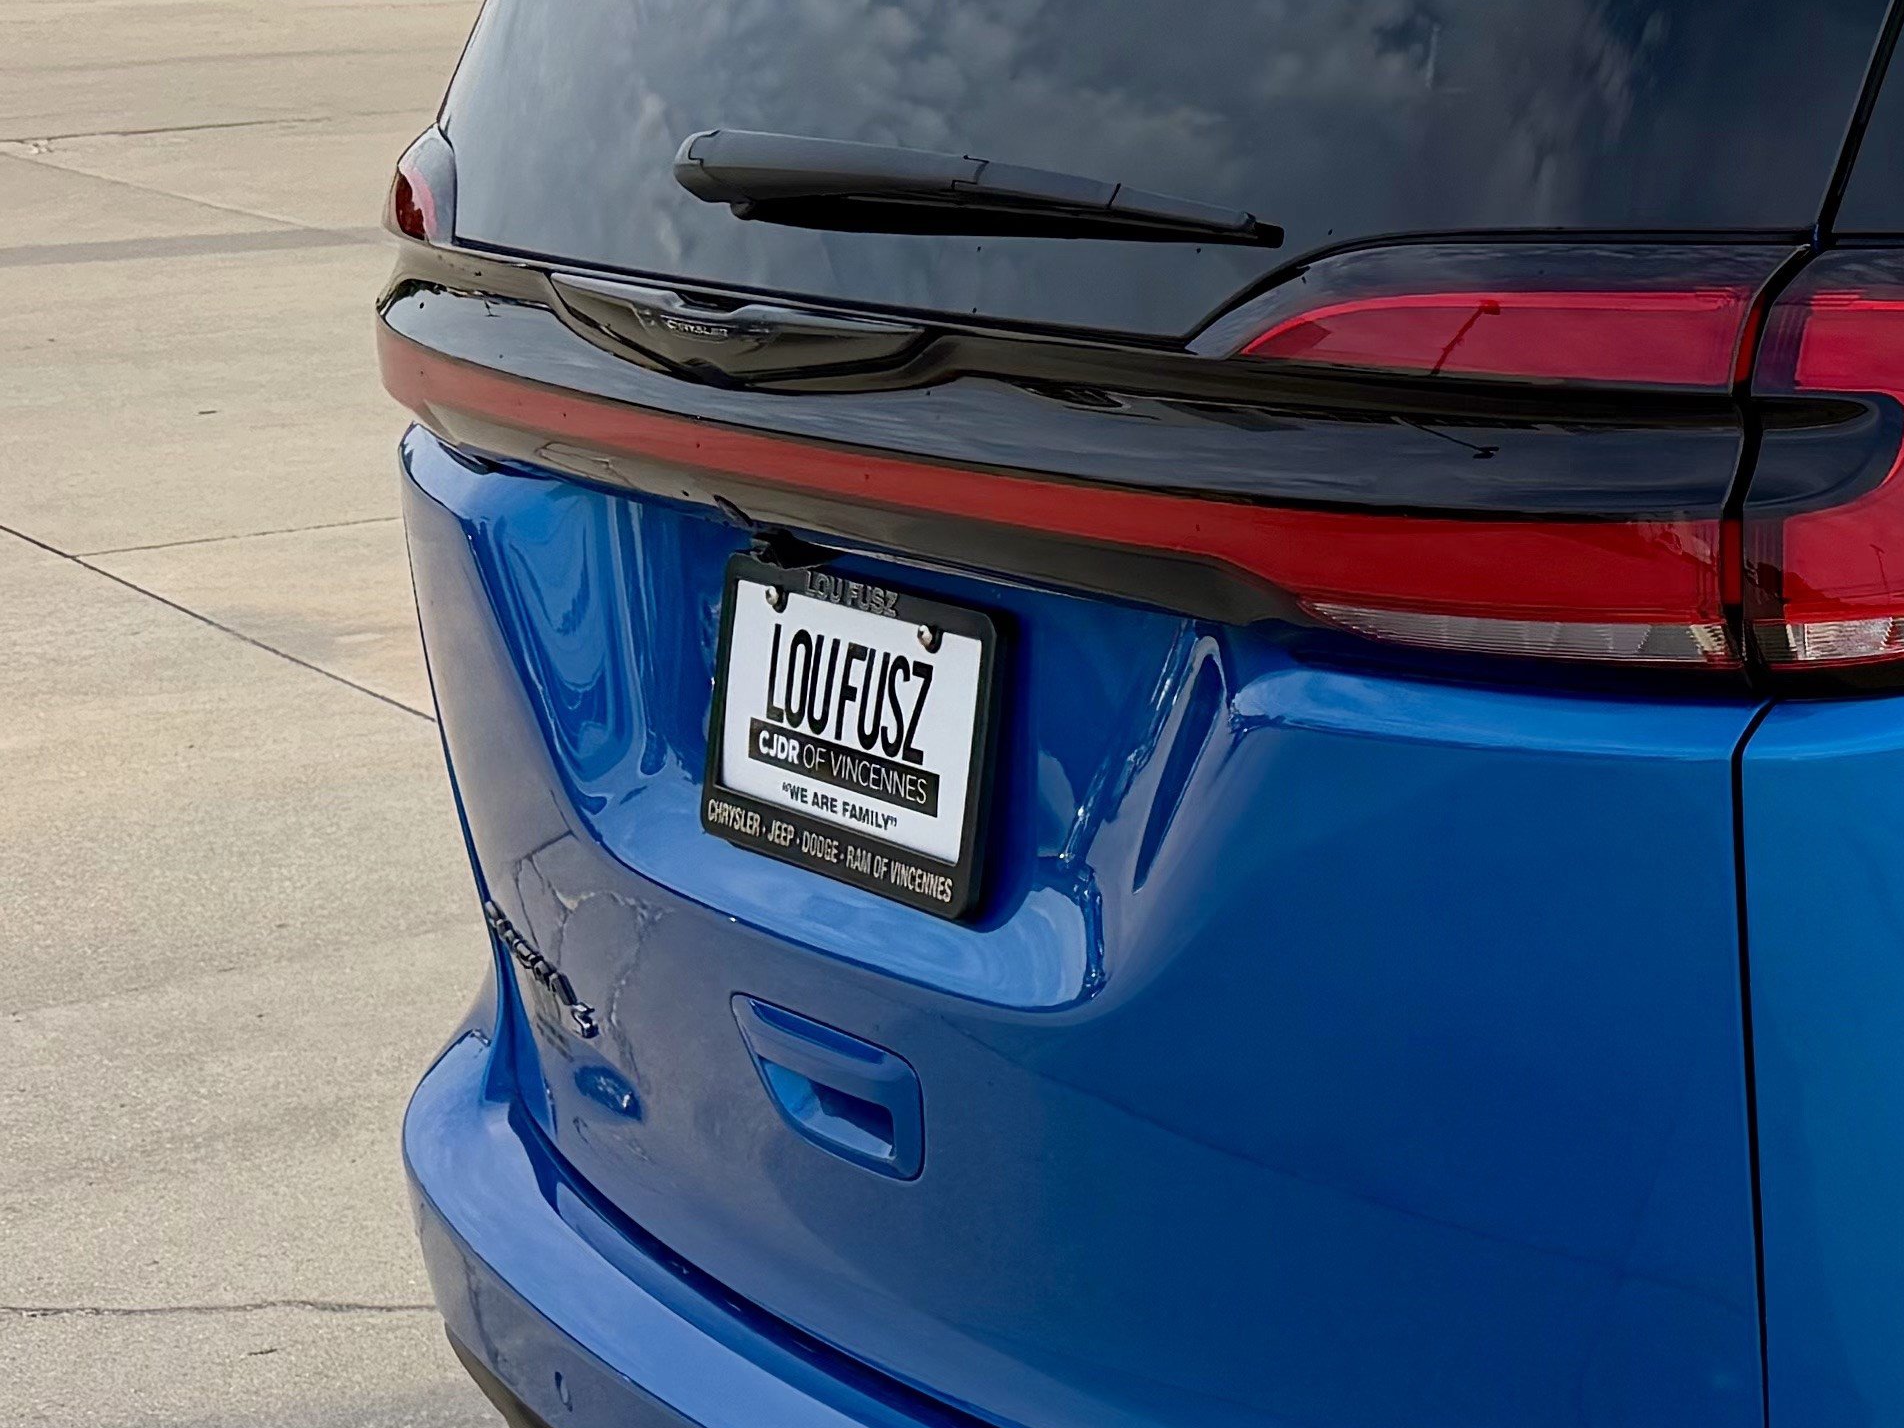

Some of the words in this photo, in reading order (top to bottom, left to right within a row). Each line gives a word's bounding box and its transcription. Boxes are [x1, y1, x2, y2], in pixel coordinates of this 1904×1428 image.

[804, 570, 844, 604] LOU
[844, 579, 899, 618] FUSZ
[766, 623, 841, 735] LOU
[834, 642, 934, 765] FUSZ
[758, 730, 800, 764] CJDR
[802, 743, 826, 771] OF
[830, 750, 928, 805] VINCENNES
[811, 791, 838, 814] ARE
[707, 798, 761, 837] CHRYSLER
[767, 819, 795, 847] JEEP
[801, 830, 839, 864] DODGE
[846, 845, 871, 873] RAM
[873, 855, 888, 879] OF
[890, 862, 953, 903] VINCENNES
